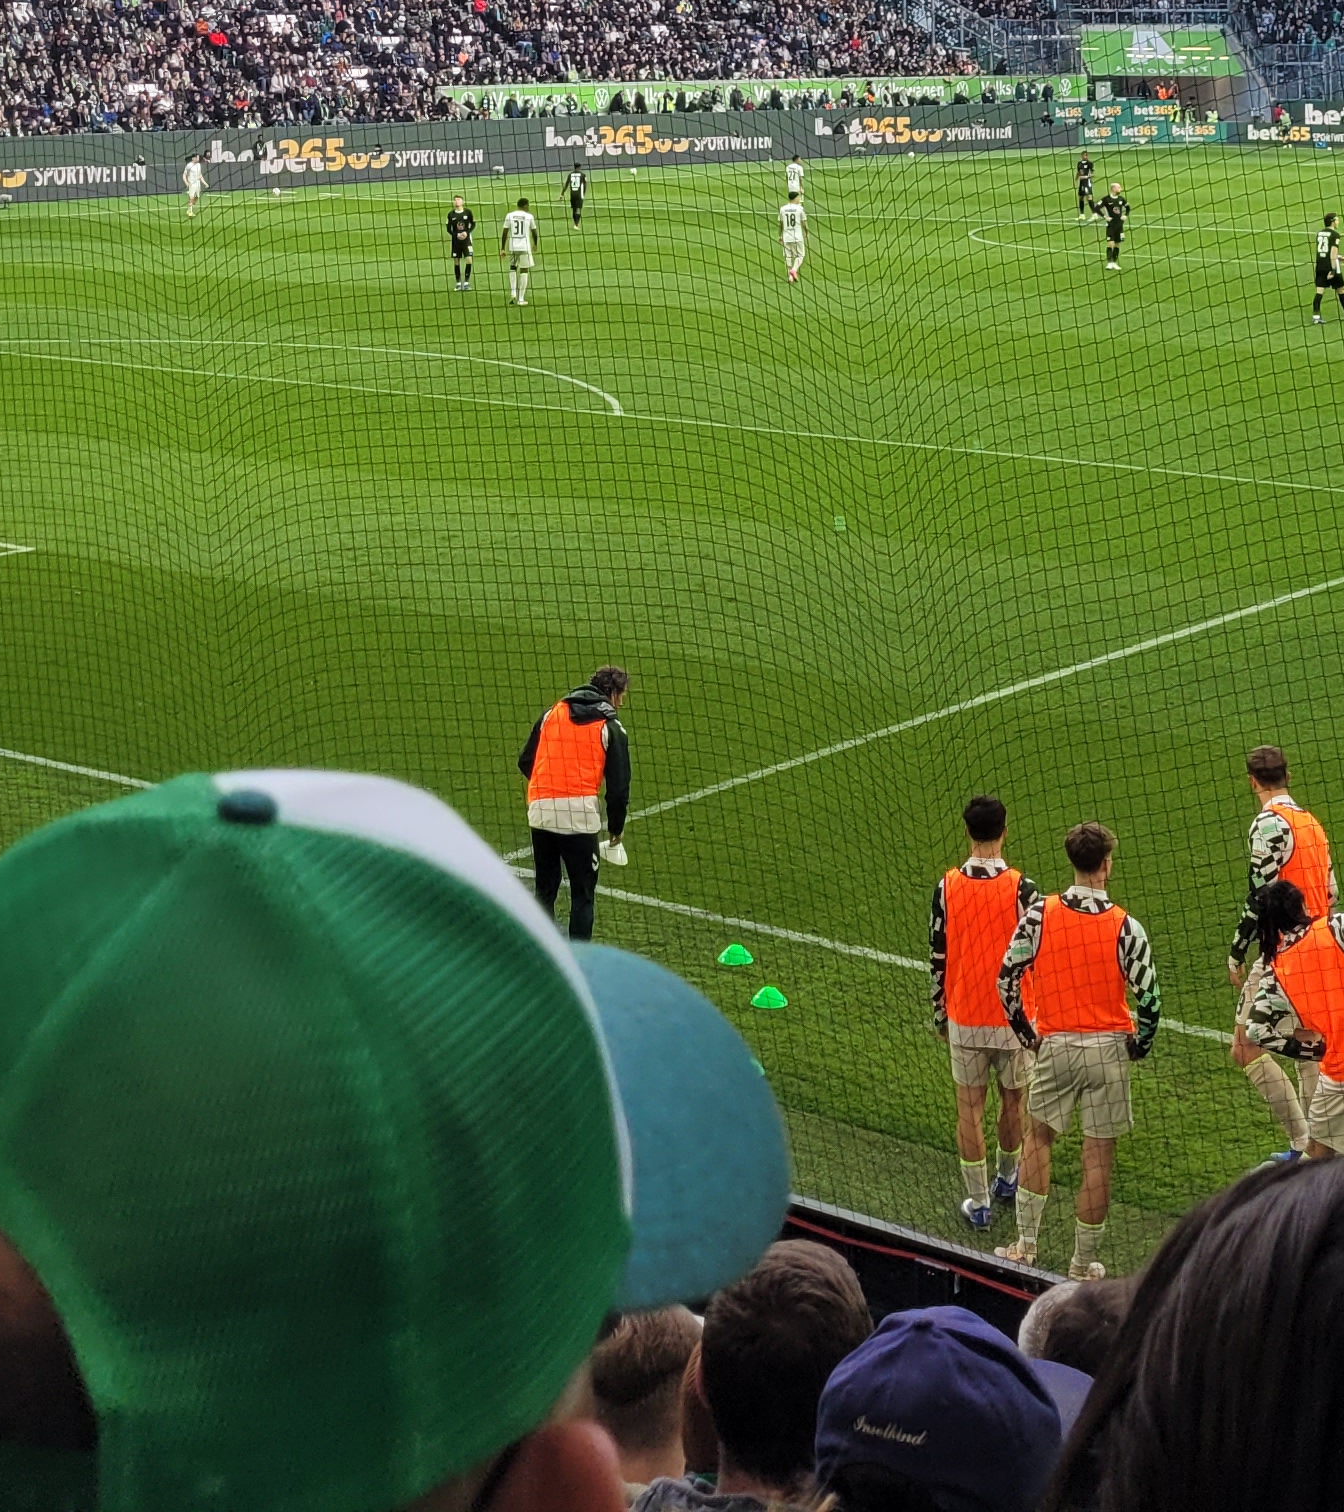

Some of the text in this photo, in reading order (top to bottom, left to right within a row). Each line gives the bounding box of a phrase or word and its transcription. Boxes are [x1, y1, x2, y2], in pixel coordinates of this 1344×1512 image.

[1122, 125, 1158, 137] bet365
[513, 219, 524, 235] 31
[785, 213, 796, 228] 18
